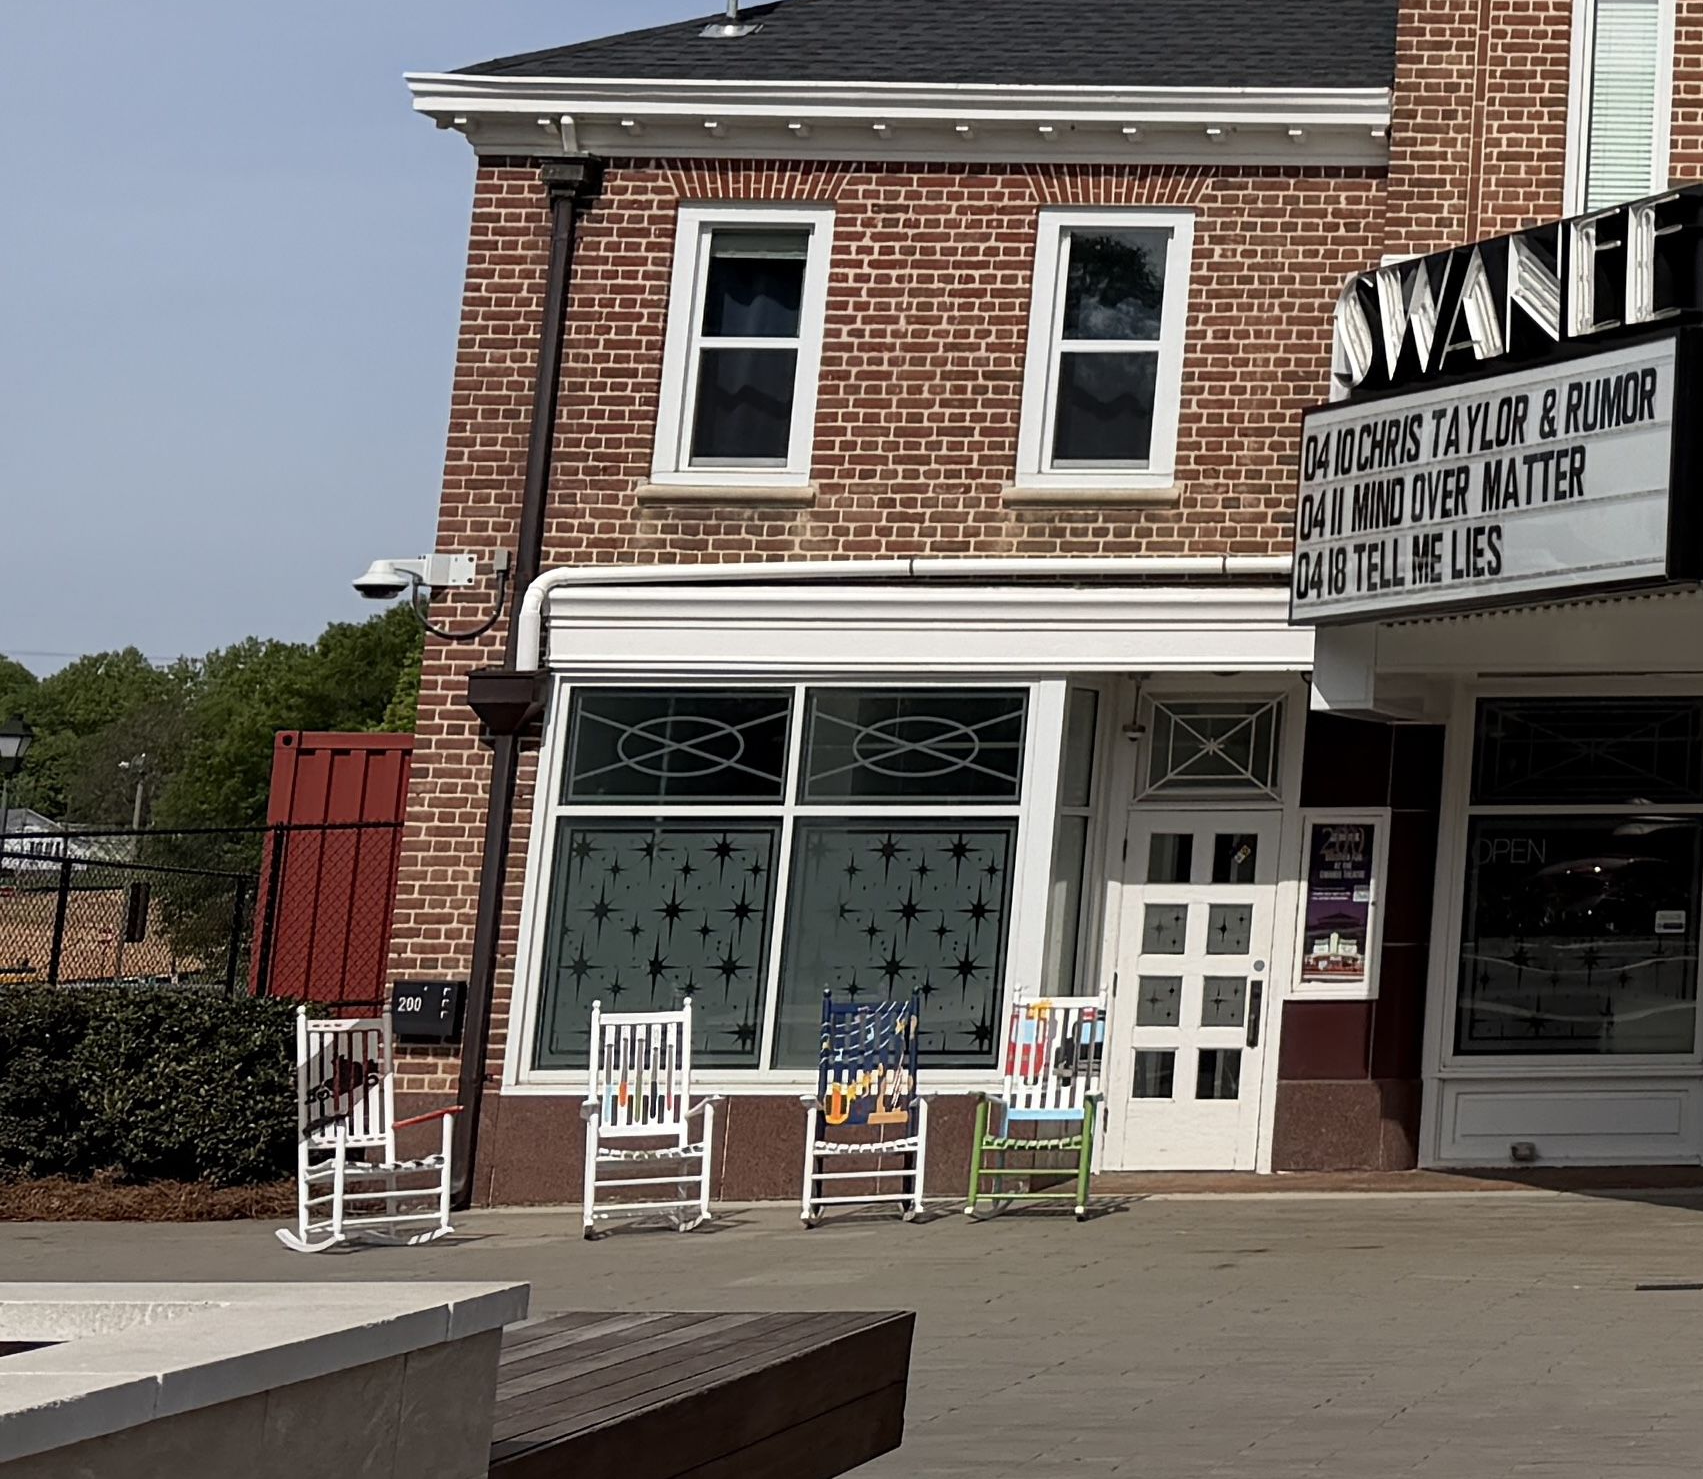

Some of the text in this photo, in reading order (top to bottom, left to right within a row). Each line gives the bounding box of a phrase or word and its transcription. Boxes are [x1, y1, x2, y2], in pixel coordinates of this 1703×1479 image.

[1333, 193, 1683, 389] SWANEE
[1304, 430, 1331, 482] 04
[1356, 413, 1423, 472] CHRIS
[1431, 393, 1529, 458] TAYLOR
[1539, 388, 1557, 440] &
[1564, 367, 1657, 435] RUMOR
[1300, 444, 1586, 541] 04 11 MIND OVER MATTER
[1296, 524, 1503, 600] 04 18 TELL ME LIES
[1472, 837, 1546, 865] OPEN
[397, 996, 422, 1012] 200
